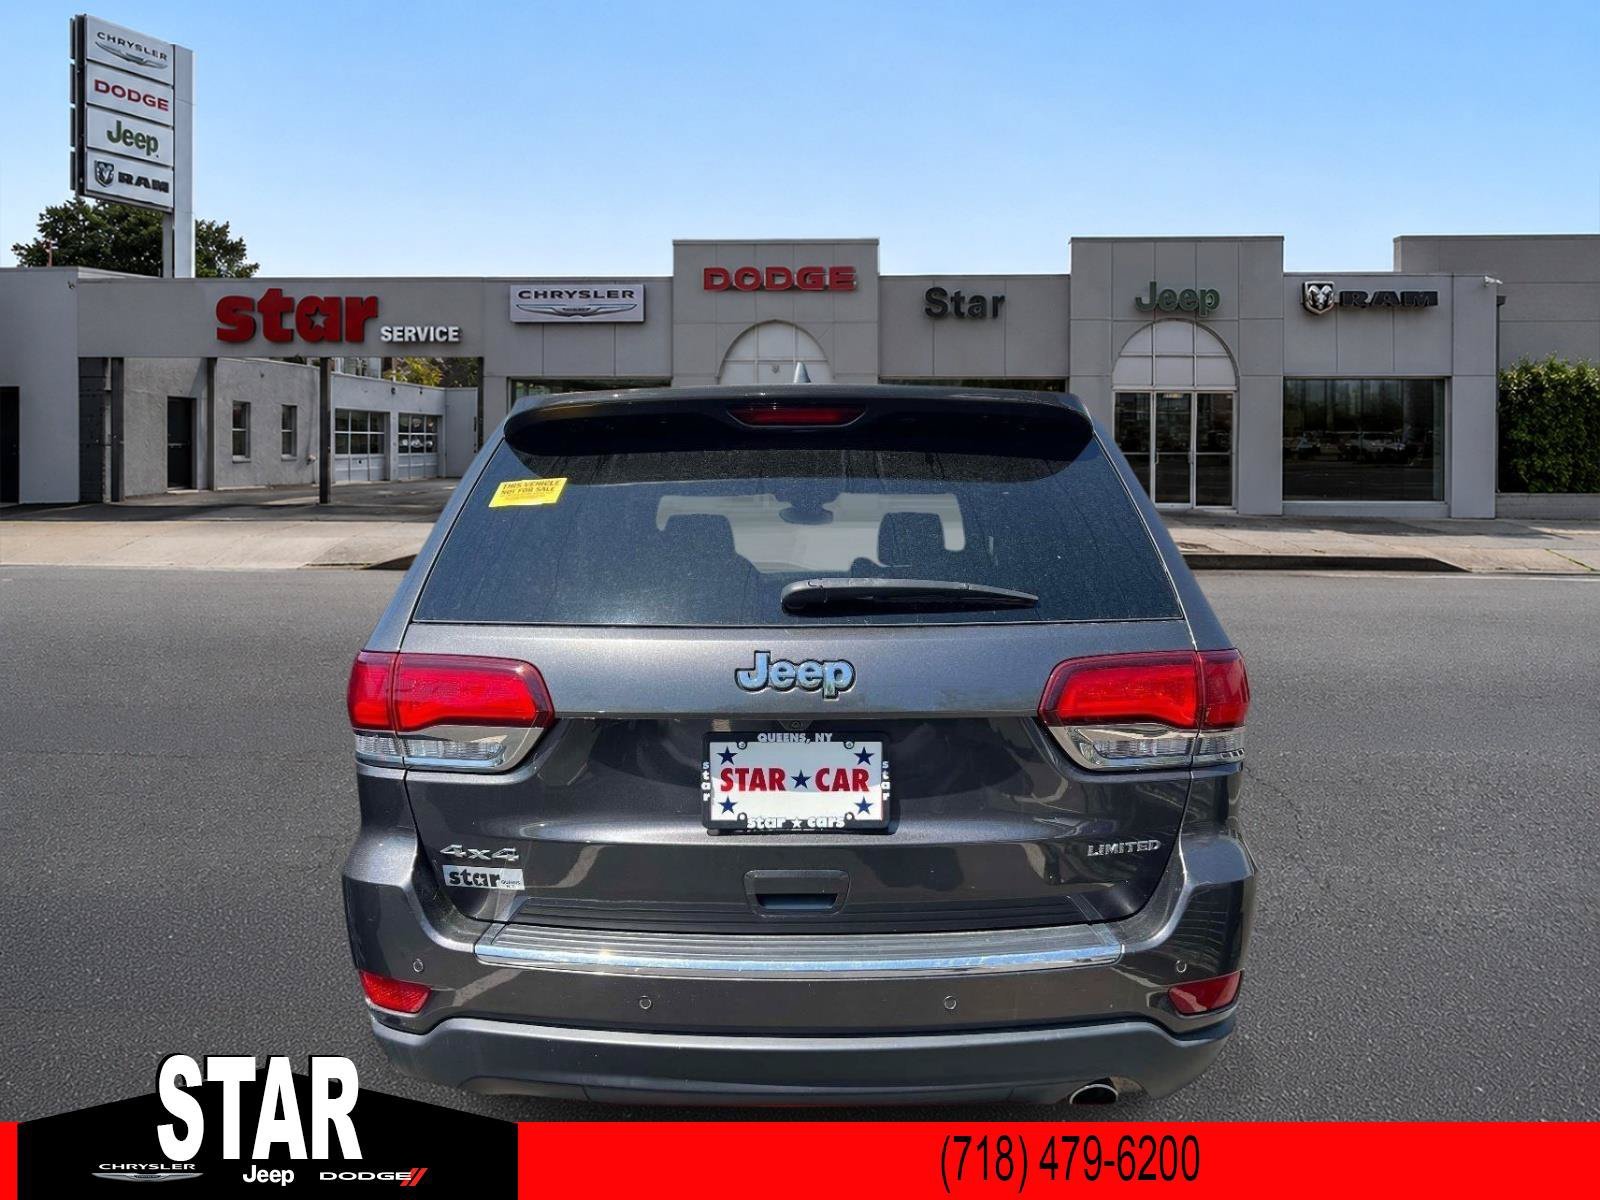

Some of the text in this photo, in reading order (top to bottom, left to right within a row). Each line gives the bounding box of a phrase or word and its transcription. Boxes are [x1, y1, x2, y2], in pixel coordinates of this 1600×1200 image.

[97, 31, 168, 61] CHRYSLER
[94, 79, 169, 112] DODGE
[106, 120, 159, 157] Jeep
[118, 171, 170, 193] RAM
[704, 266, 856, 291] DODGE
[518, 289, 635, 300] CHRYSLER
[924, 287, 1006, 318] Star
[1134, 281, 1220, 316] Jeep
[1339, 290, 1438, 307] RAM
[216, 288, 460, 343] star SERVICE
[735, 650, 857, 700] Jeep
[757, 733, 833, 744] QUEENS, NY
[720, 768, 870, 792] STAR CAR
[747, 816, 846, 829] star cars
[1087, 840, 1161, 856] LIMITED
[449, 869, 500, 887] star
